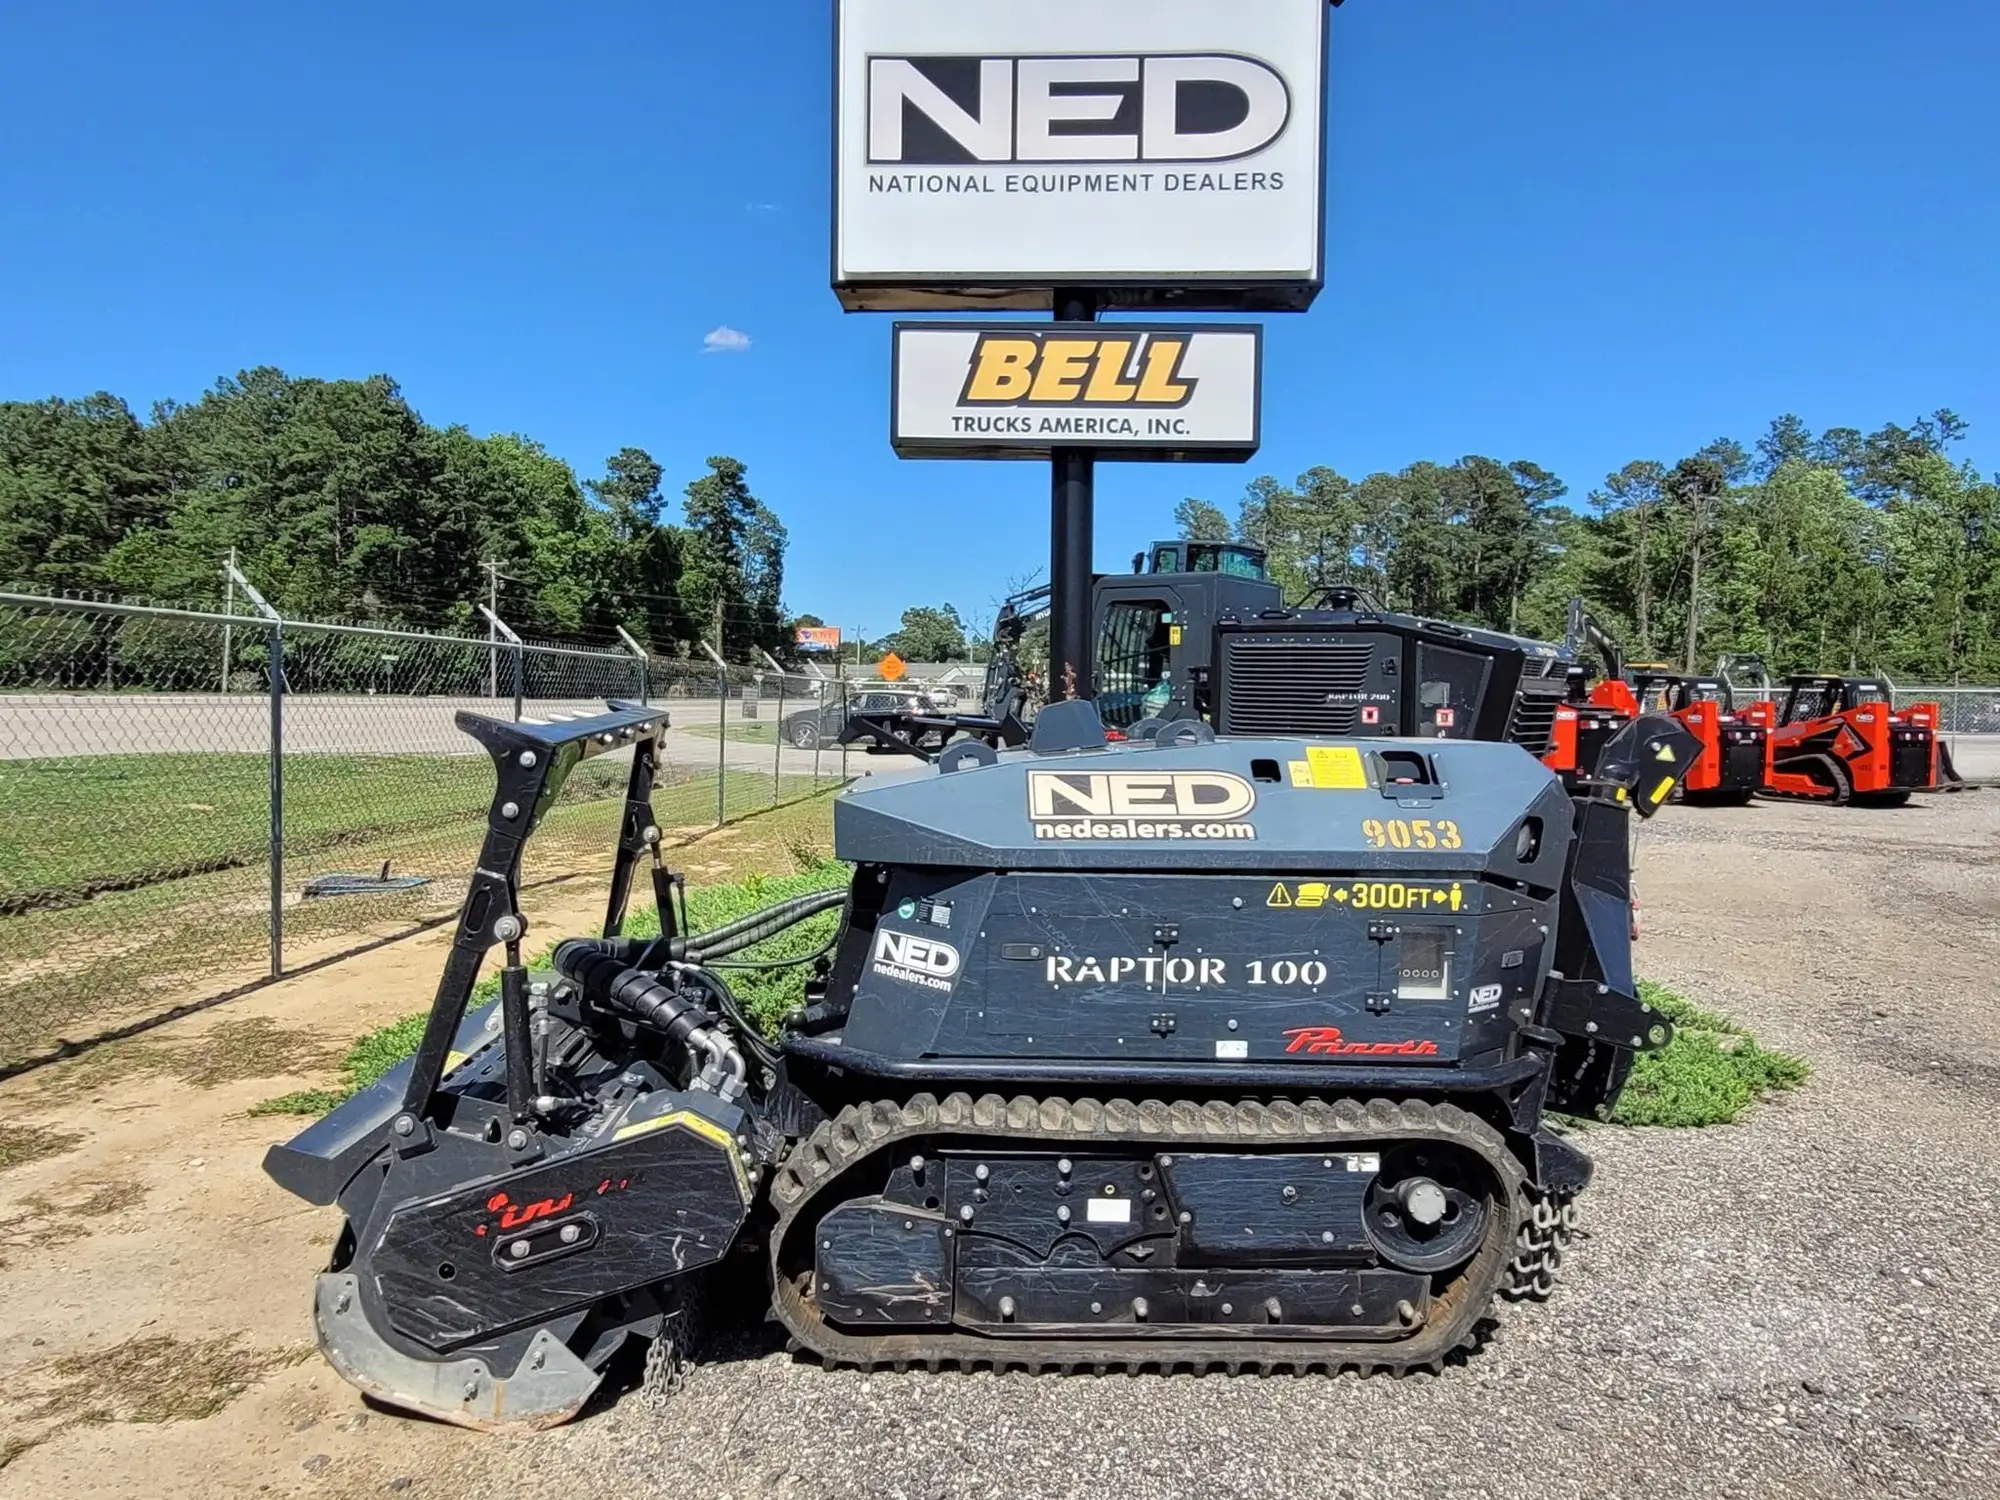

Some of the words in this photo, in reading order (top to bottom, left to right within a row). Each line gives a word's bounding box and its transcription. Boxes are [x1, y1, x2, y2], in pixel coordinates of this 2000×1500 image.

[867, 55, 1290, 163] NED
[868, 174, 995, 193] NATIONAL
[1005, 173, 1154, 193] EQUIPMENT
[1164, 172, 1285, 191] DEALERS
[960, 336, 1194, 406] BELL
[952, 416, 1032, 433] TRUCKS
[1039, 418, 1140, 437] AMERICA,
[1148, 418, 1191, 435] INC.
[1030, 771, 1255, 818] NED
[1035, 820, 1255, 839] nedealers.com
[1362, 819, 1462, 849] 9053
[876, 930, 958, 976] NED
[873, 963, 952, 992] nedealers.com
[1046, 956, 1226, 984] RAPTOR
[1246, 960, 1328, 985] 100
[1469, 984, 1501, 1006] NED
[1282, 1027, 1438, 1055] Prinoth
